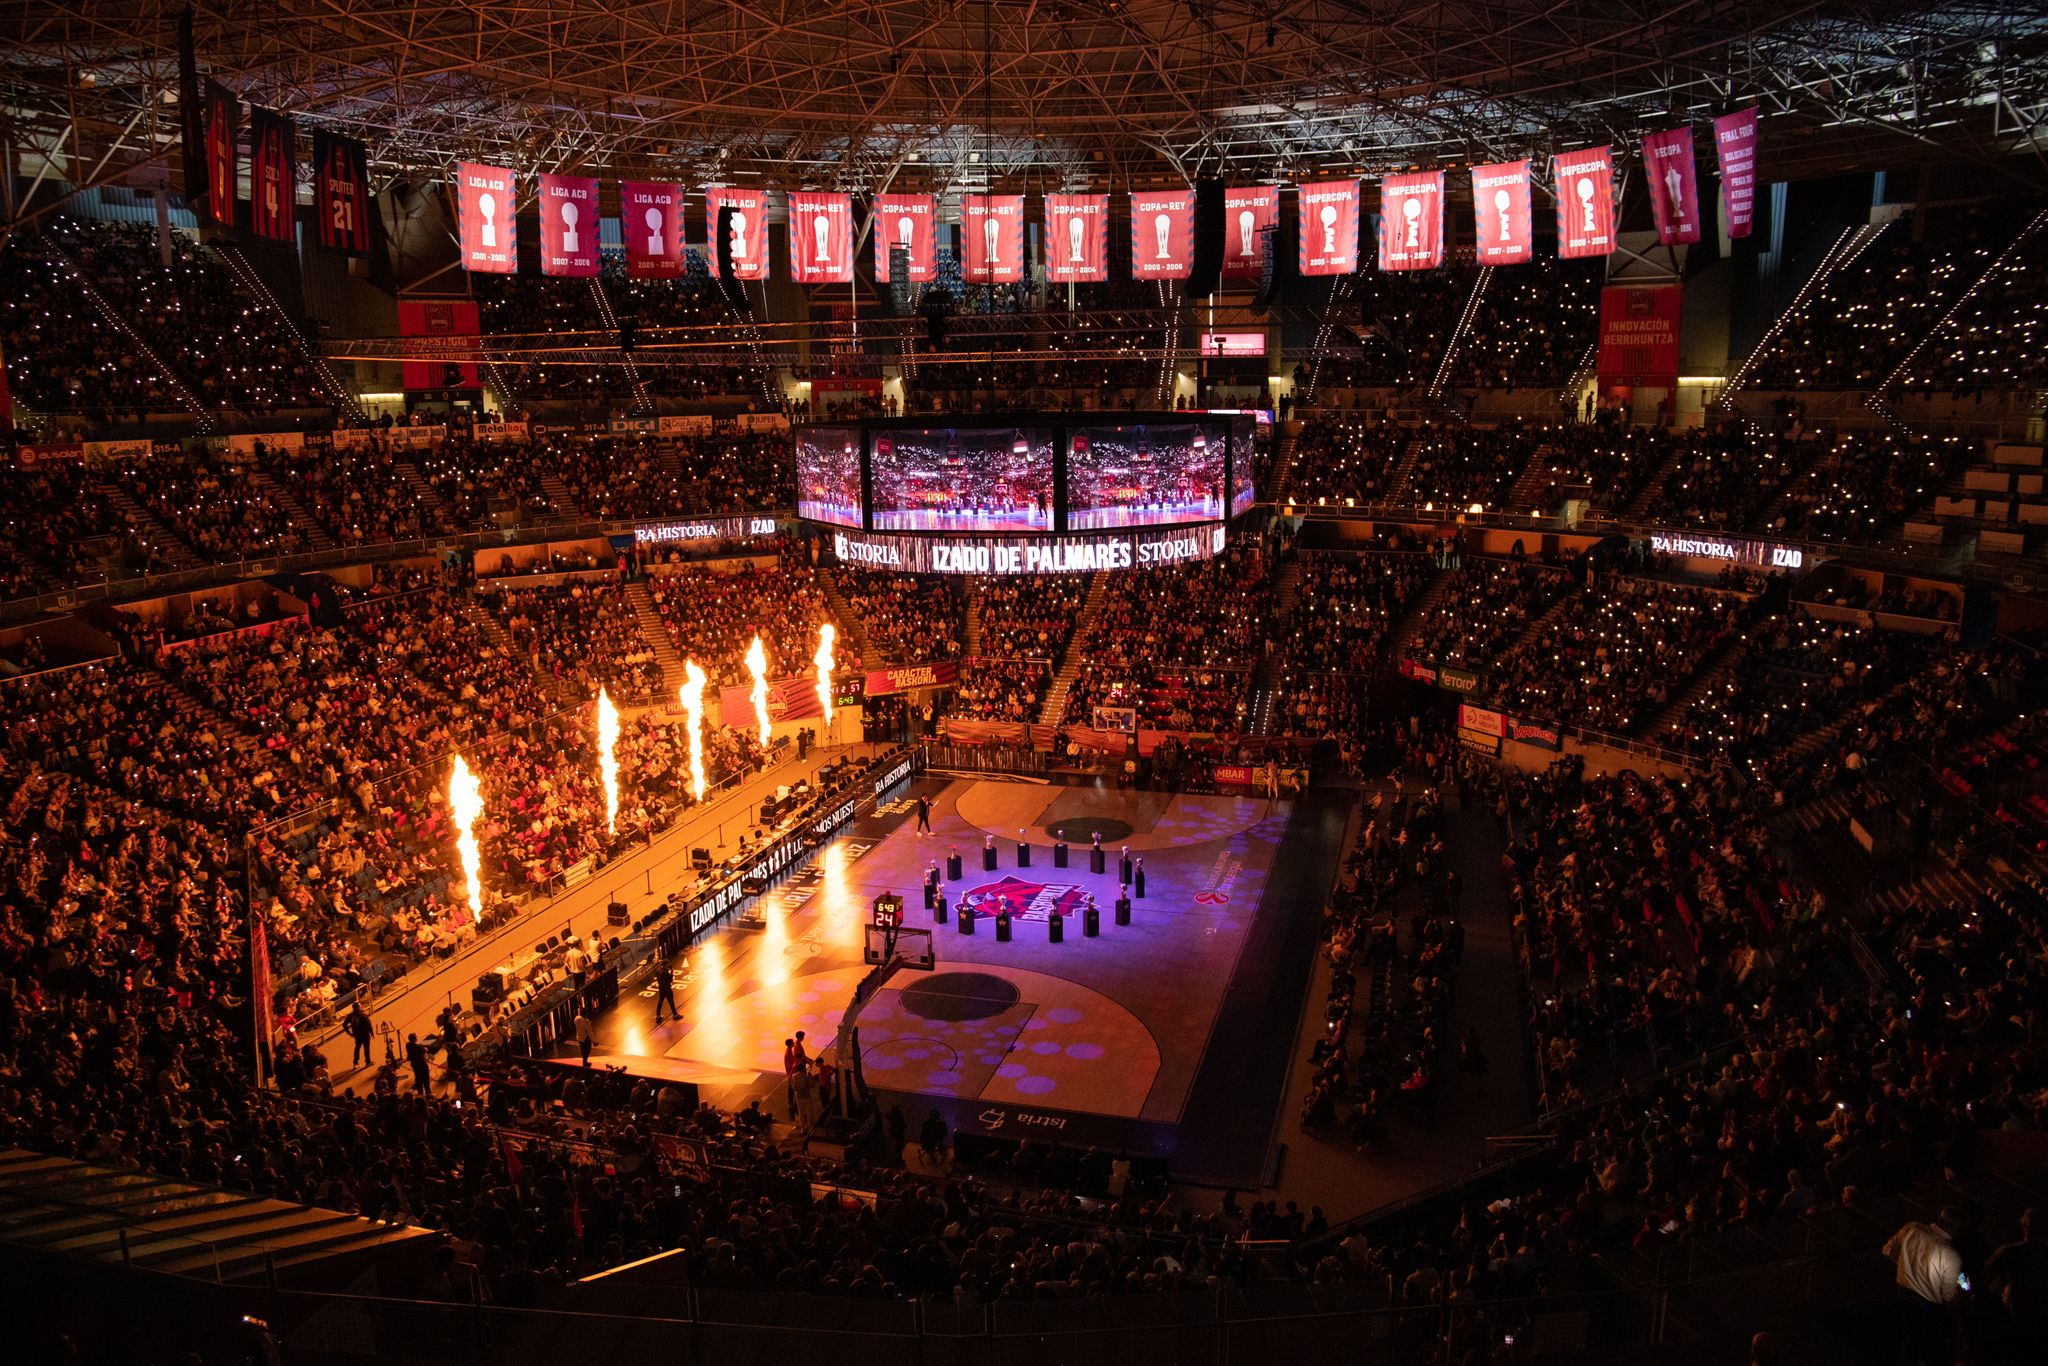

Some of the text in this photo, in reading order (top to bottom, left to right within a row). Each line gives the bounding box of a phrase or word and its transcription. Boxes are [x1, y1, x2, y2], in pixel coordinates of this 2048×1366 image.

[1720, 128, 1739, 143] FINAL
[1654, 144, 1681, 158] RECOPA
[1561, 160, 1606, 176] SUPERCOPA
[329, 178, 354, 195] SPLITTER
[470, 176, 504, 190] LIGA ACB
[1479, 174, 1523, 188] SUPERCOPA
[551, 187, 587, 199] LIGA ACB
[1389, 183, 1437, 196] SUPERCOPA
[266, 182, 278, 218] 4
[635, 194, 671, 204] LIGA ACB
[1225, 199, 1245, 208] COPA
[1254, 198, 1270, 206] REY
[1306, 192, 1352, 203] SUPERCOPA
[798, 203, 820, 212] COPA
[828, 204, 844, 212] REY
[883, 204, 904, 213] COPA
[969, 206, 990, 215] COPA
[999, 206, 1014, 215] REY
[1054, 206, 1075, 214] COPA
[1083, 205, 1100, 214] REY
[1140, 202, 1162, 212] COPA
[1170, 202, 1185, 210] REY
[333, 199, 352, 230] 21
[472, 252, 487, 260] 2001
[1610, 316, 1669, 332] INNOVACIÓN
[1604, 334, 1674, 345] BERRIKUNTZA
[1632, 377, 1641, 386] 12
[307, 436, 331, 444] 315-B
[154, 444, 180, 453] 315-A
[659, 525, 717, 539] HISTORIA
[850, 542, 901, 564] STORIA
[932, 546, 988, 571] IZADO
[994, 546, 1022, 572] DE
[1027, 539, 1132, 571] PALMARÉS
[1138, 537, 1198, 562] STORIA
[1673, 539, 1734, 557] HISTORIA
[896, 675, 936, 687] BASKONIA
[1111, 689, 1122, 697] 24
[876, 760, 911, 795] RA HISTORIA
[1210, 769, 1244, 779] AMBAR
[832, 800, 854, 826] NUEST
[716, 891, 727, 914] DE
[690, 899, 715, 933] IZADO
[876, 913, 893, 926] 24
[1018, 1113, 1067, 1129] Istria
